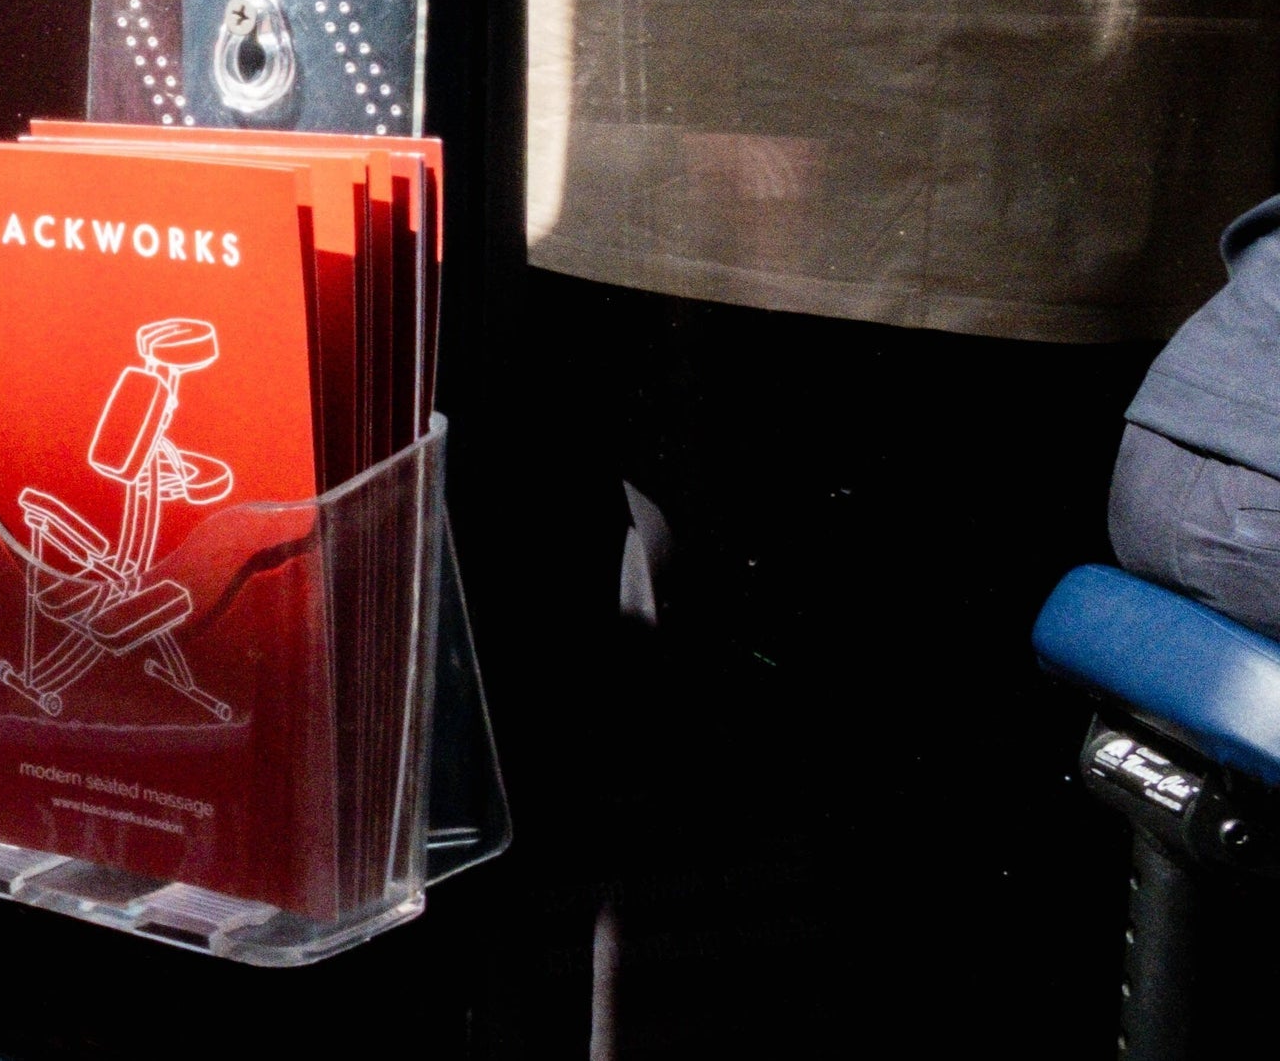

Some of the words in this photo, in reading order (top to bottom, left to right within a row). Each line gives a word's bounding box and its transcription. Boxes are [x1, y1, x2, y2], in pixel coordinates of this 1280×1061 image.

[19, 761, 83, 787] modern
[85, 772, 140, 800] seated
[142, 787, 215, 819] massage
